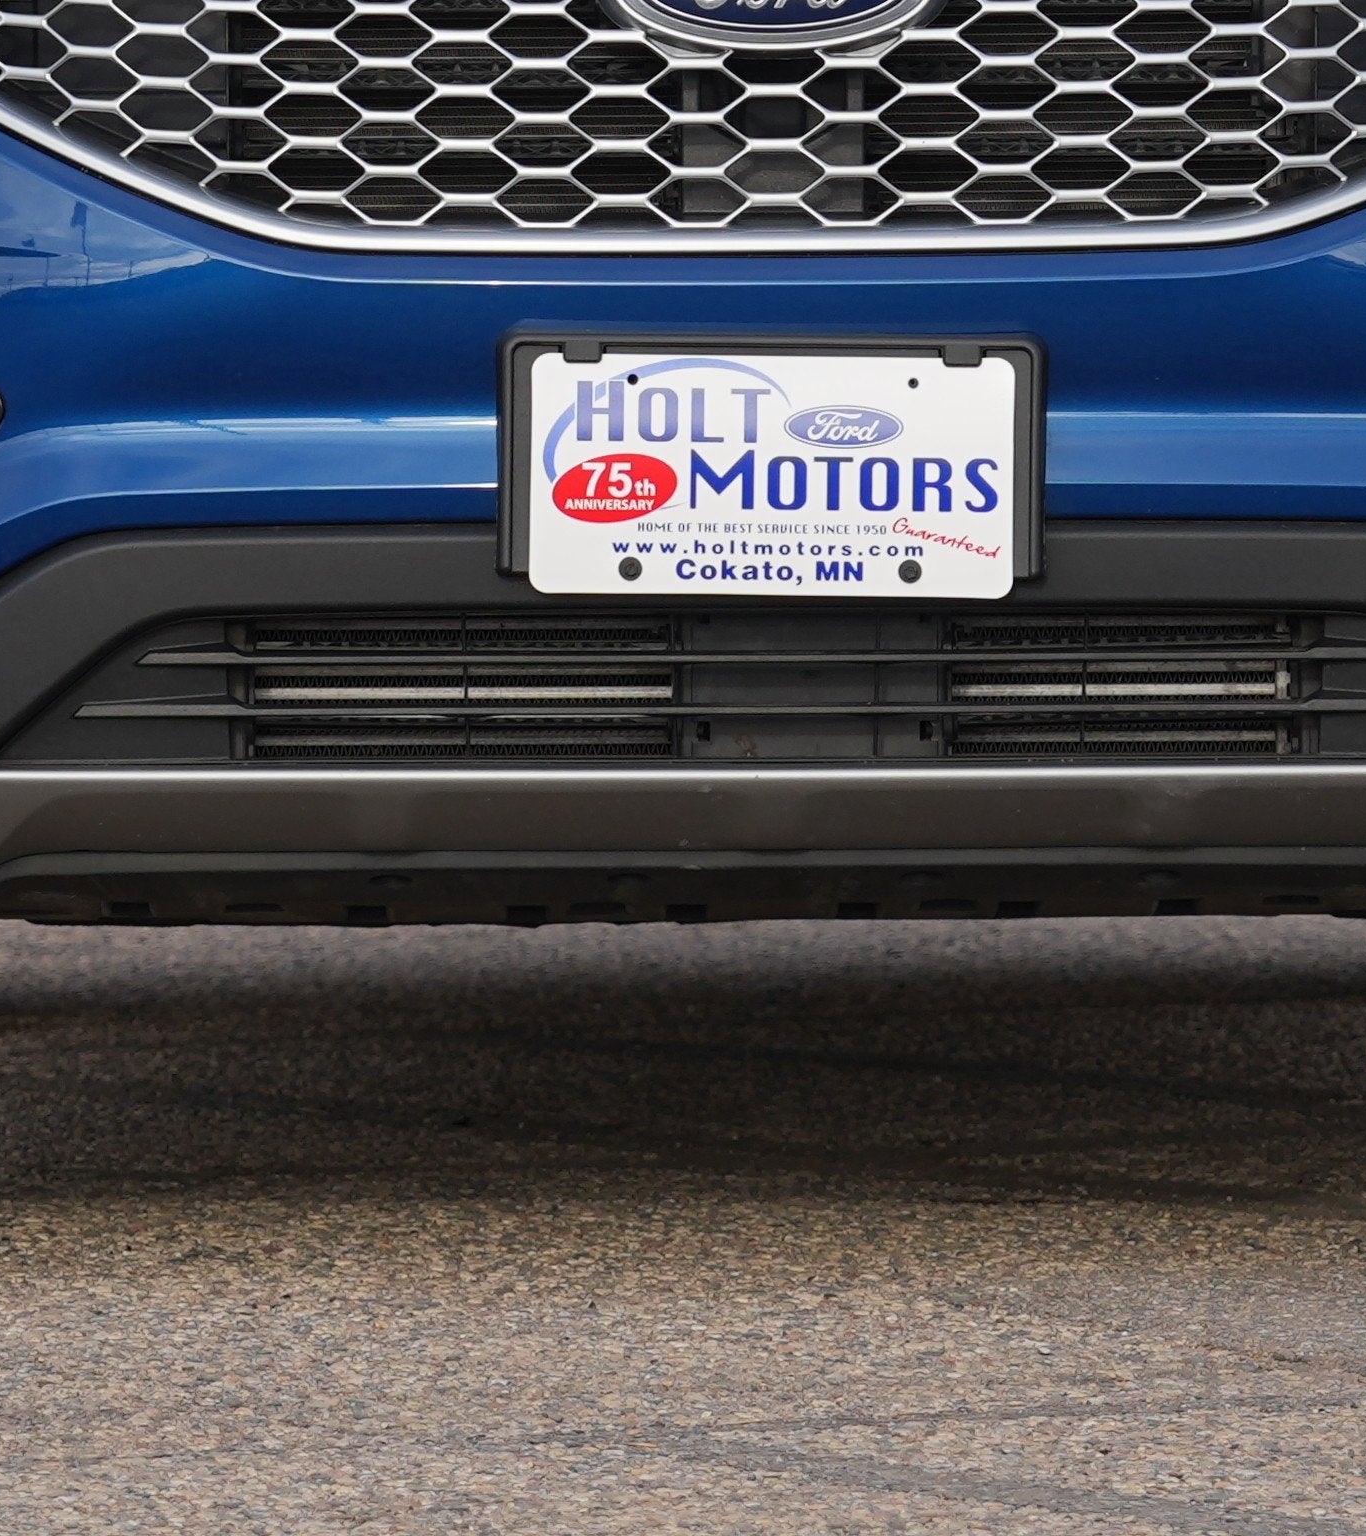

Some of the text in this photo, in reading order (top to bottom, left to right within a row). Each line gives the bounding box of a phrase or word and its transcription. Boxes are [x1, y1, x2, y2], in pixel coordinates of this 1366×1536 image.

[575, 380, 771, 444] HOLT
[807, 411, 880, 442] Ford
[582, 462, 656, 497] 75th
[689, 448, 999, 513] MOTORS
[564, 498, 655, 511] ANNIVERSARY
[637, 522, 888, 535] HOME OF THE BEST SERVICE SINCE 1950
[892, 517, 1002, 560] Guaranteed
[612, 540, 925, 557] www.holtmotors.com
[675, 560, 864, 585] Cokato, MN
